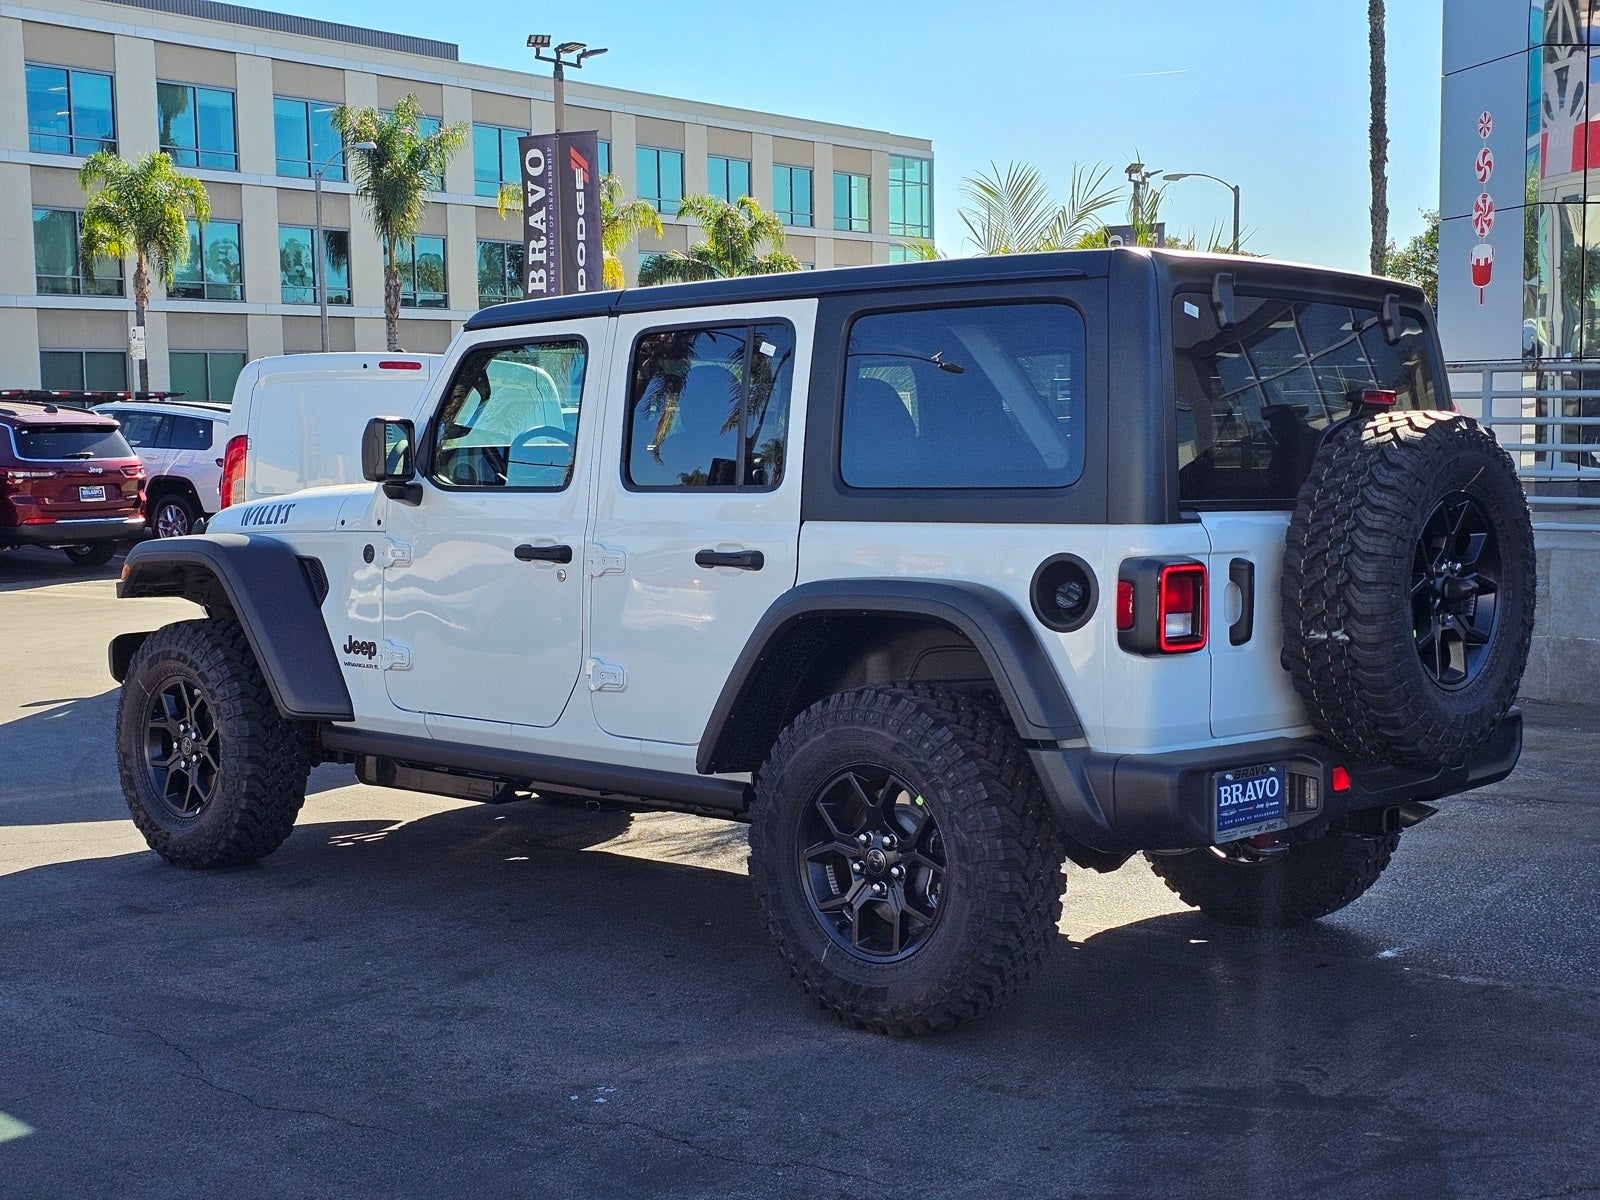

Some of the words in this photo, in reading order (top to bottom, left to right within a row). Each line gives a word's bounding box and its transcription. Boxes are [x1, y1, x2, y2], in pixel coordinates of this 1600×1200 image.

[525, 148, 547, 294] BRAVO
[575, 167, 586, 292] DODGE
[88, 466, 103, 474] Jeep
[240, 503, 297, 526] WILLYS
[343, 634, 377, 660] Jeep
[1234, 765, 1268, 779] BRAVO
[1219, 776, 1279, 806] BRAVO
